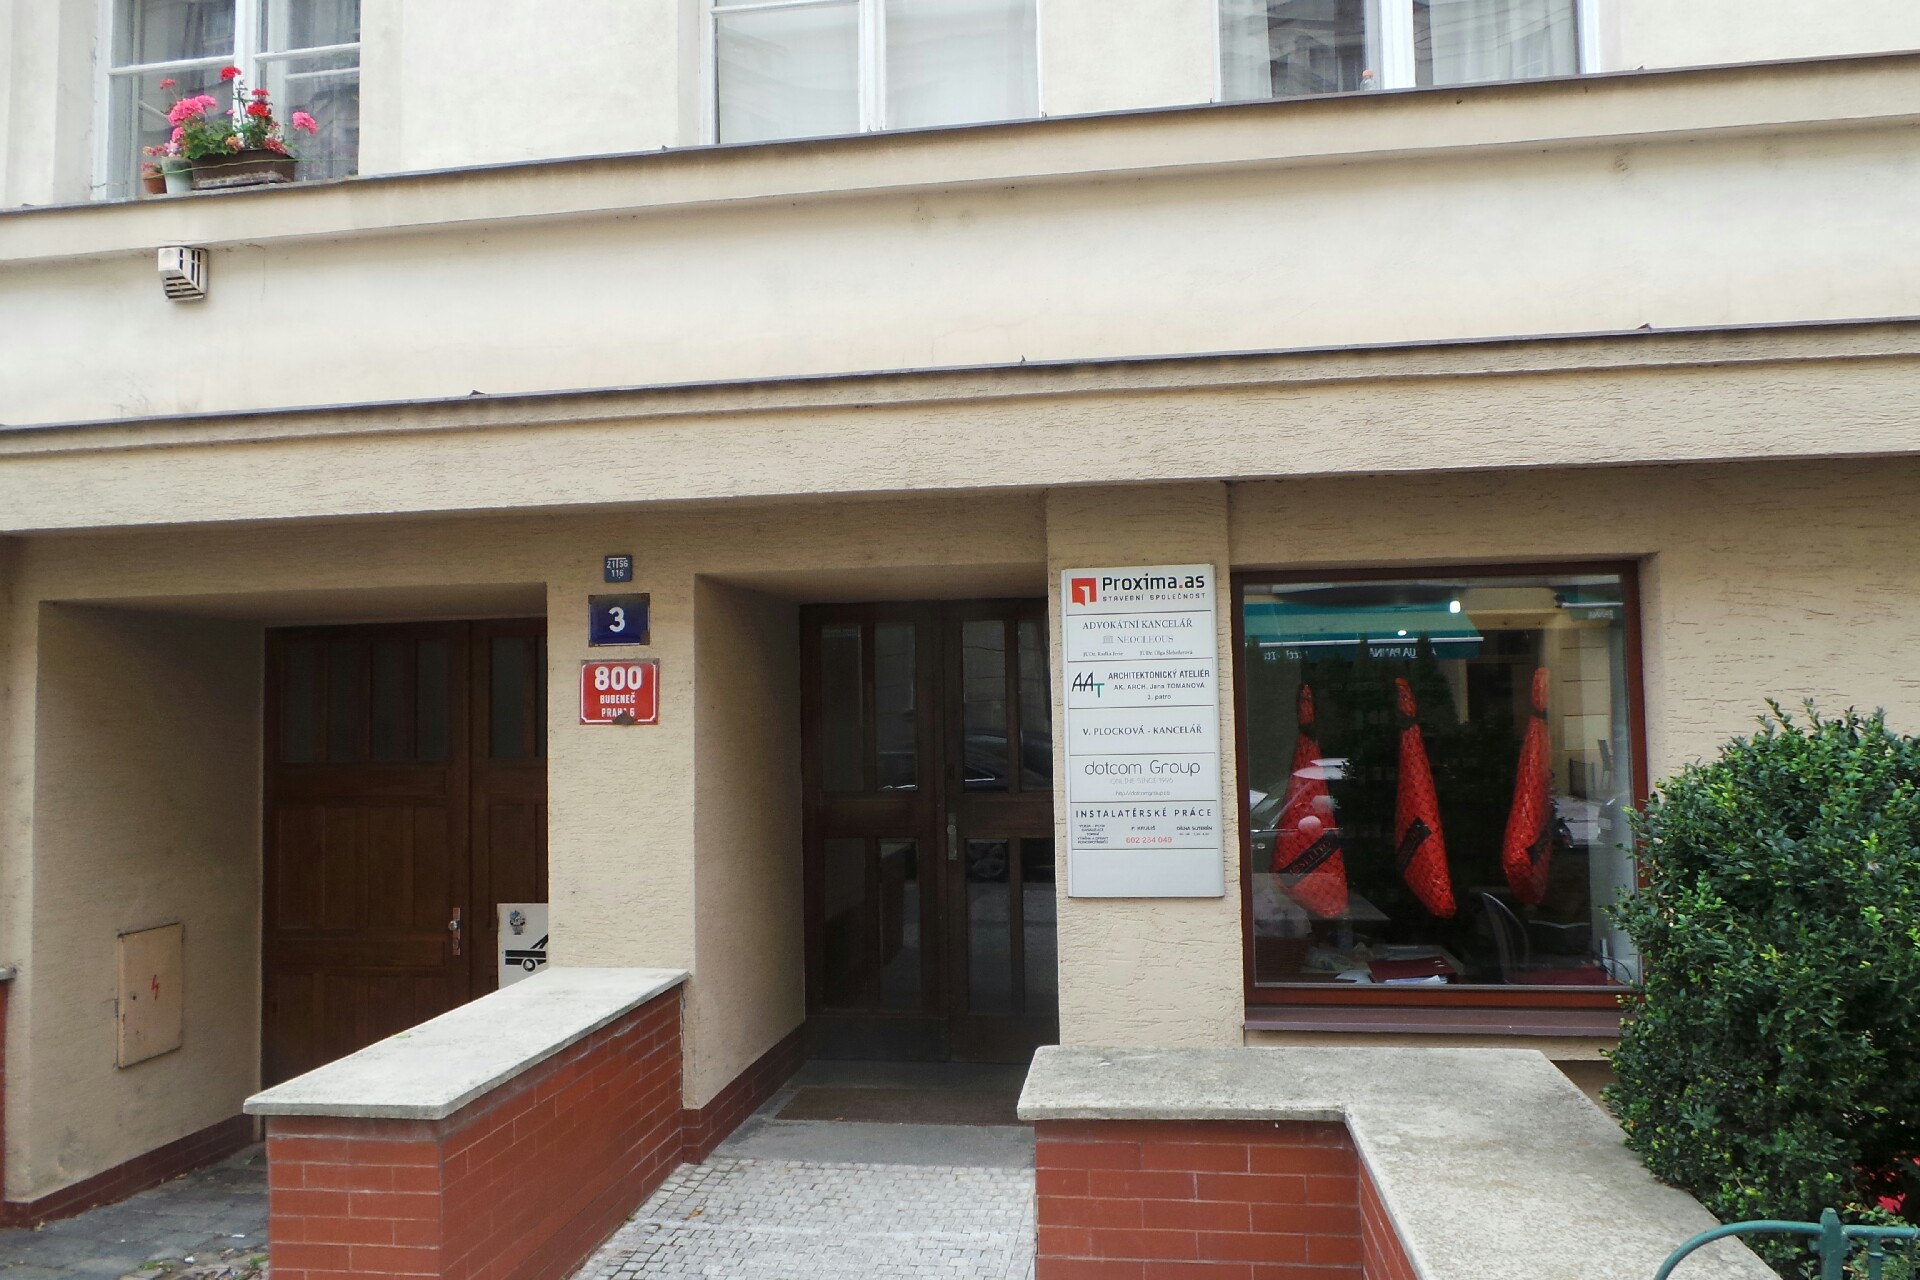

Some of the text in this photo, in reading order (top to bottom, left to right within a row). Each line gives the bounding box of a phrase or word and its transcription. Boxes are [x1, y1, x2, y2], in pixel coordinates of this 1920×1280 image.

[1102, 573, 1205, 591] Proxima.as
[1150, 593, 1206, 601] SPOLEČNOST
[608, 607, 626, 632] 3
[1083, 618, 1192, 629] ADVOKÁTNÍ KANCELÁŘ
[1117, 635, 1174, 644] NEOCLEOUS
[594, 666, 642, 690] 800
[1108, 668, 1210, 680] ARCHITEKTONICKÝ ATELIÉR
[601, 708, 635, 718] PRAH 6
[1094, 725, 1145, 735] PLOCKOVÁ
[1153, 724, 1203, 734] KANCELÁŘ
[1085, 760, 1200, 776] dotcom Group
[1076, 807, 1212, 818] INSTALATÉRSKÉ PRÁCE
